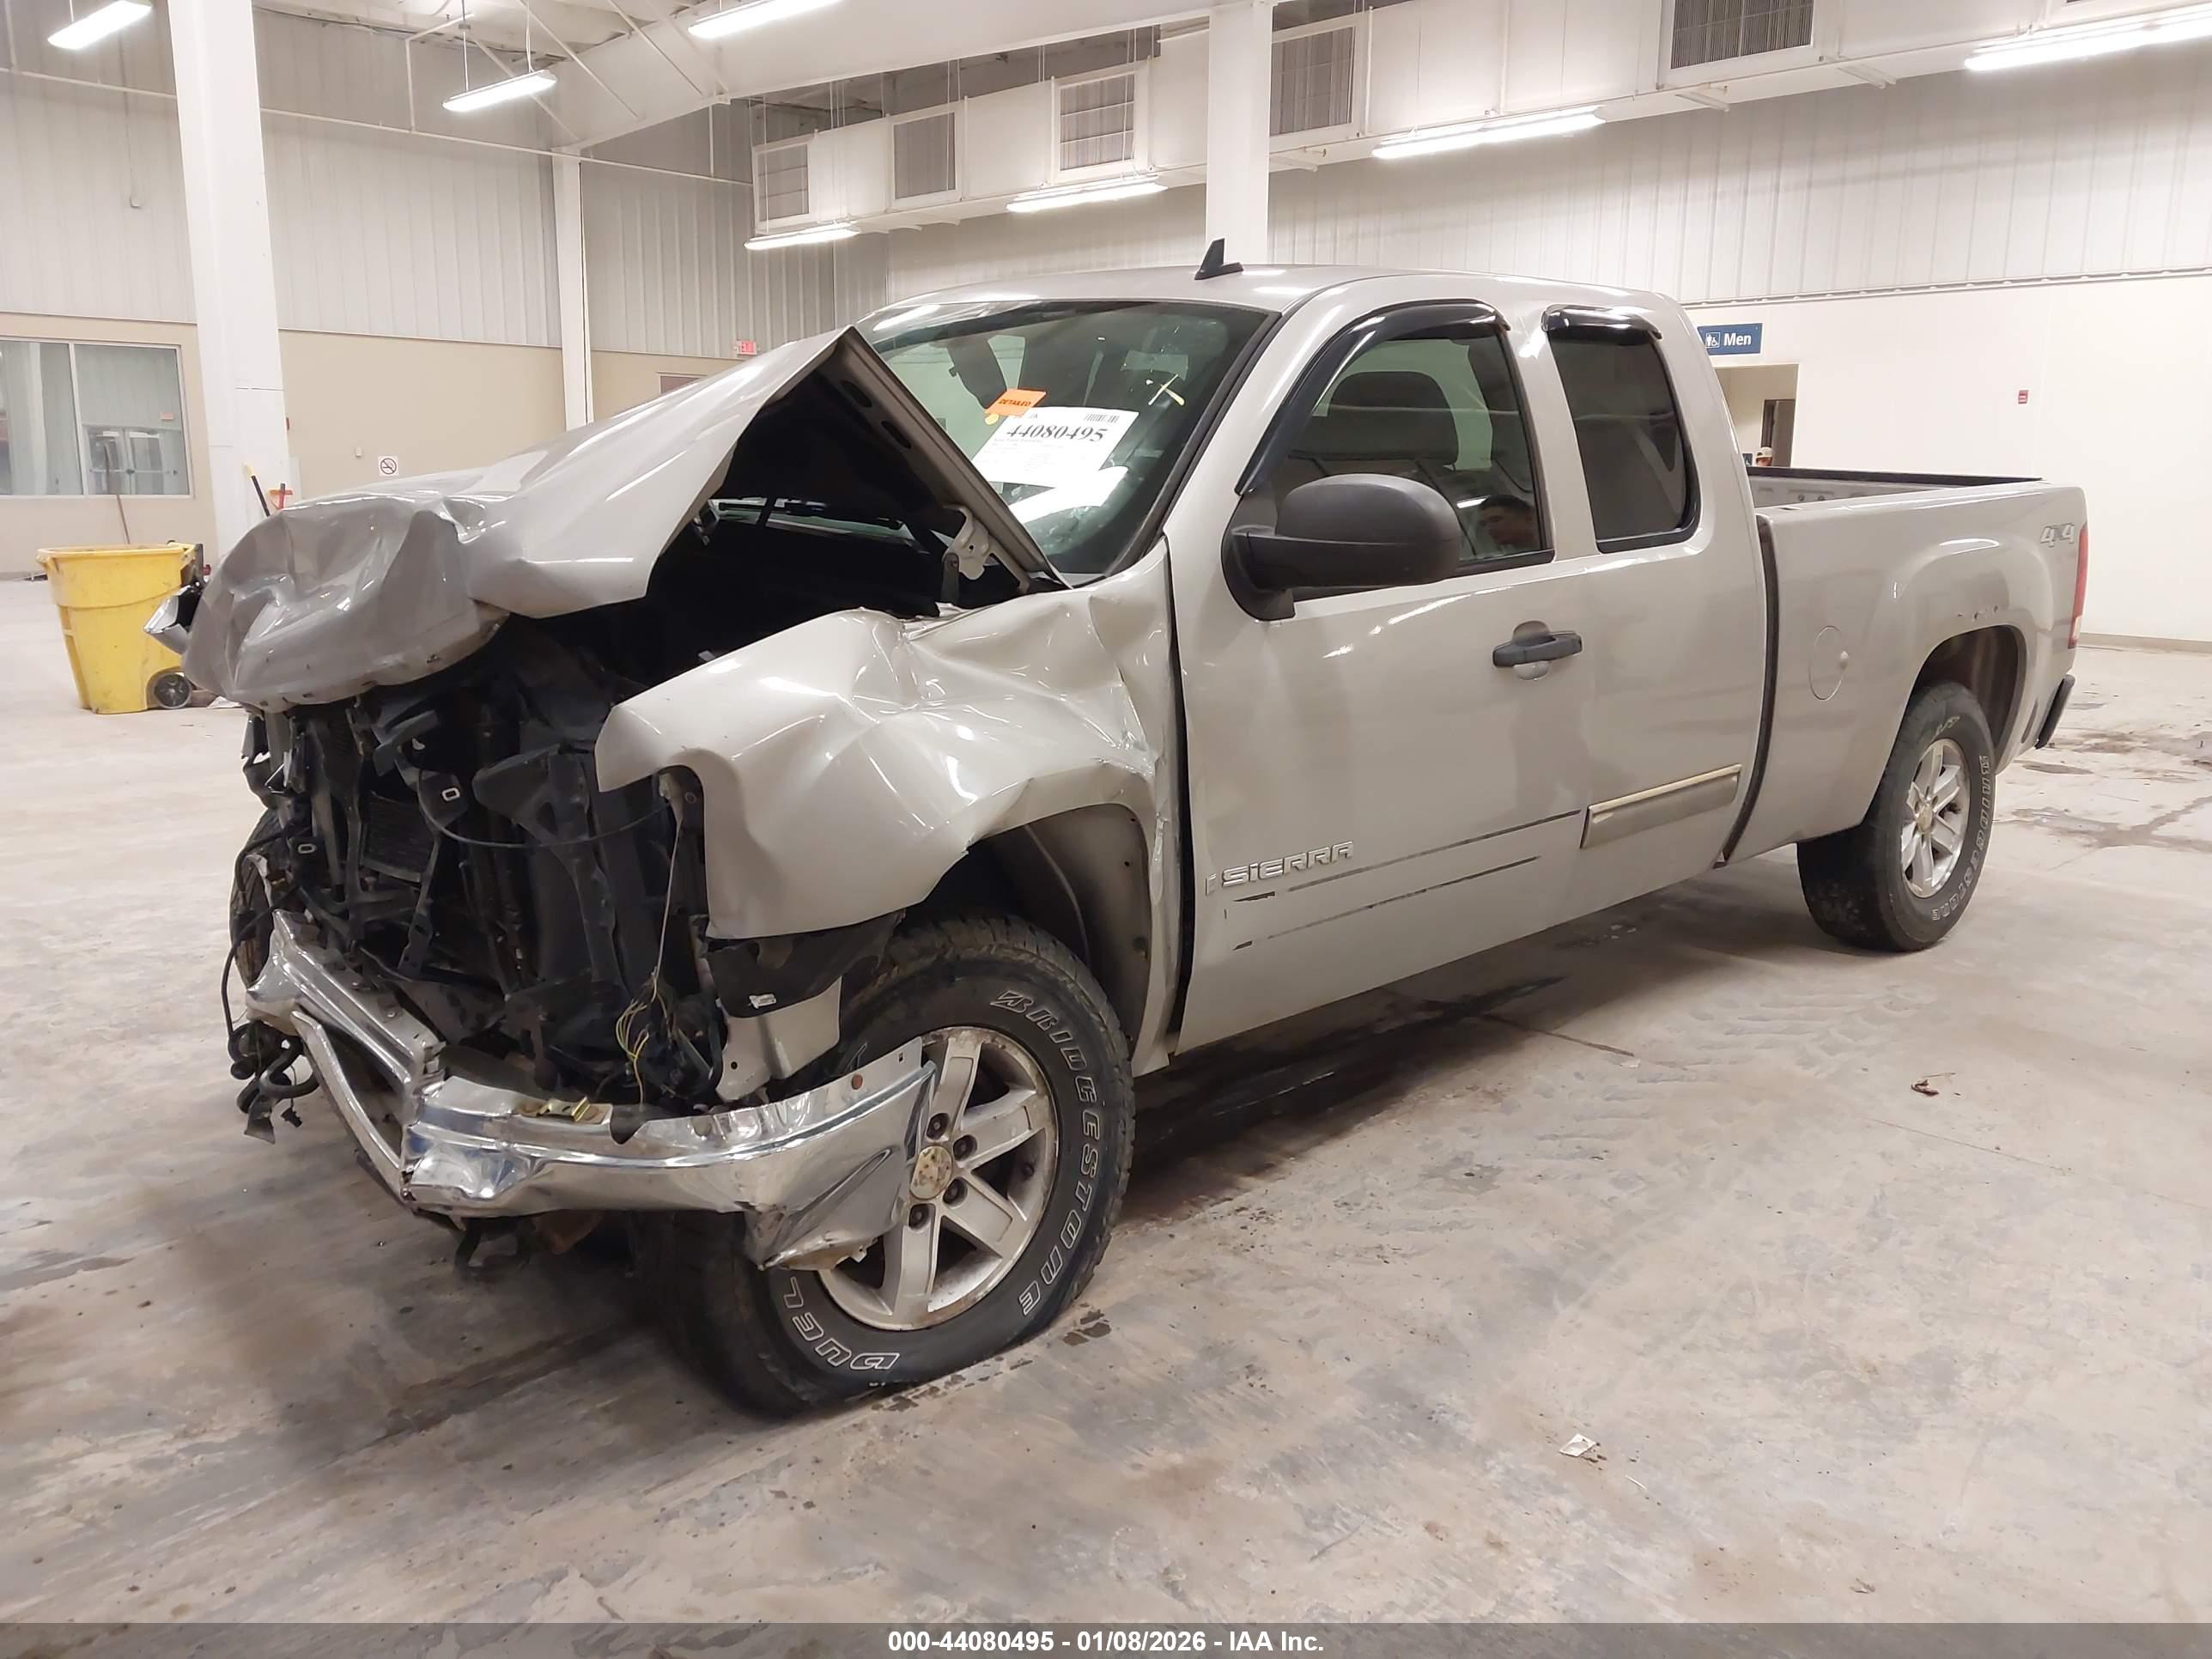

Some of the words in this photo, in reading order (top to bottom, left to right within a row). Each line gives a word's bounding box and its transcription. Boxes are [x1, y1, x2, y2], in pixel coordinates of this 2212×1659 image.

[1723, 332, 1752, 346] Men
[1006, 424, 1109, 442] 44080495
[1221, 841, 1354, 888] SIERRA
[989, 990, 1101, 1316] BRIDGESTONE
